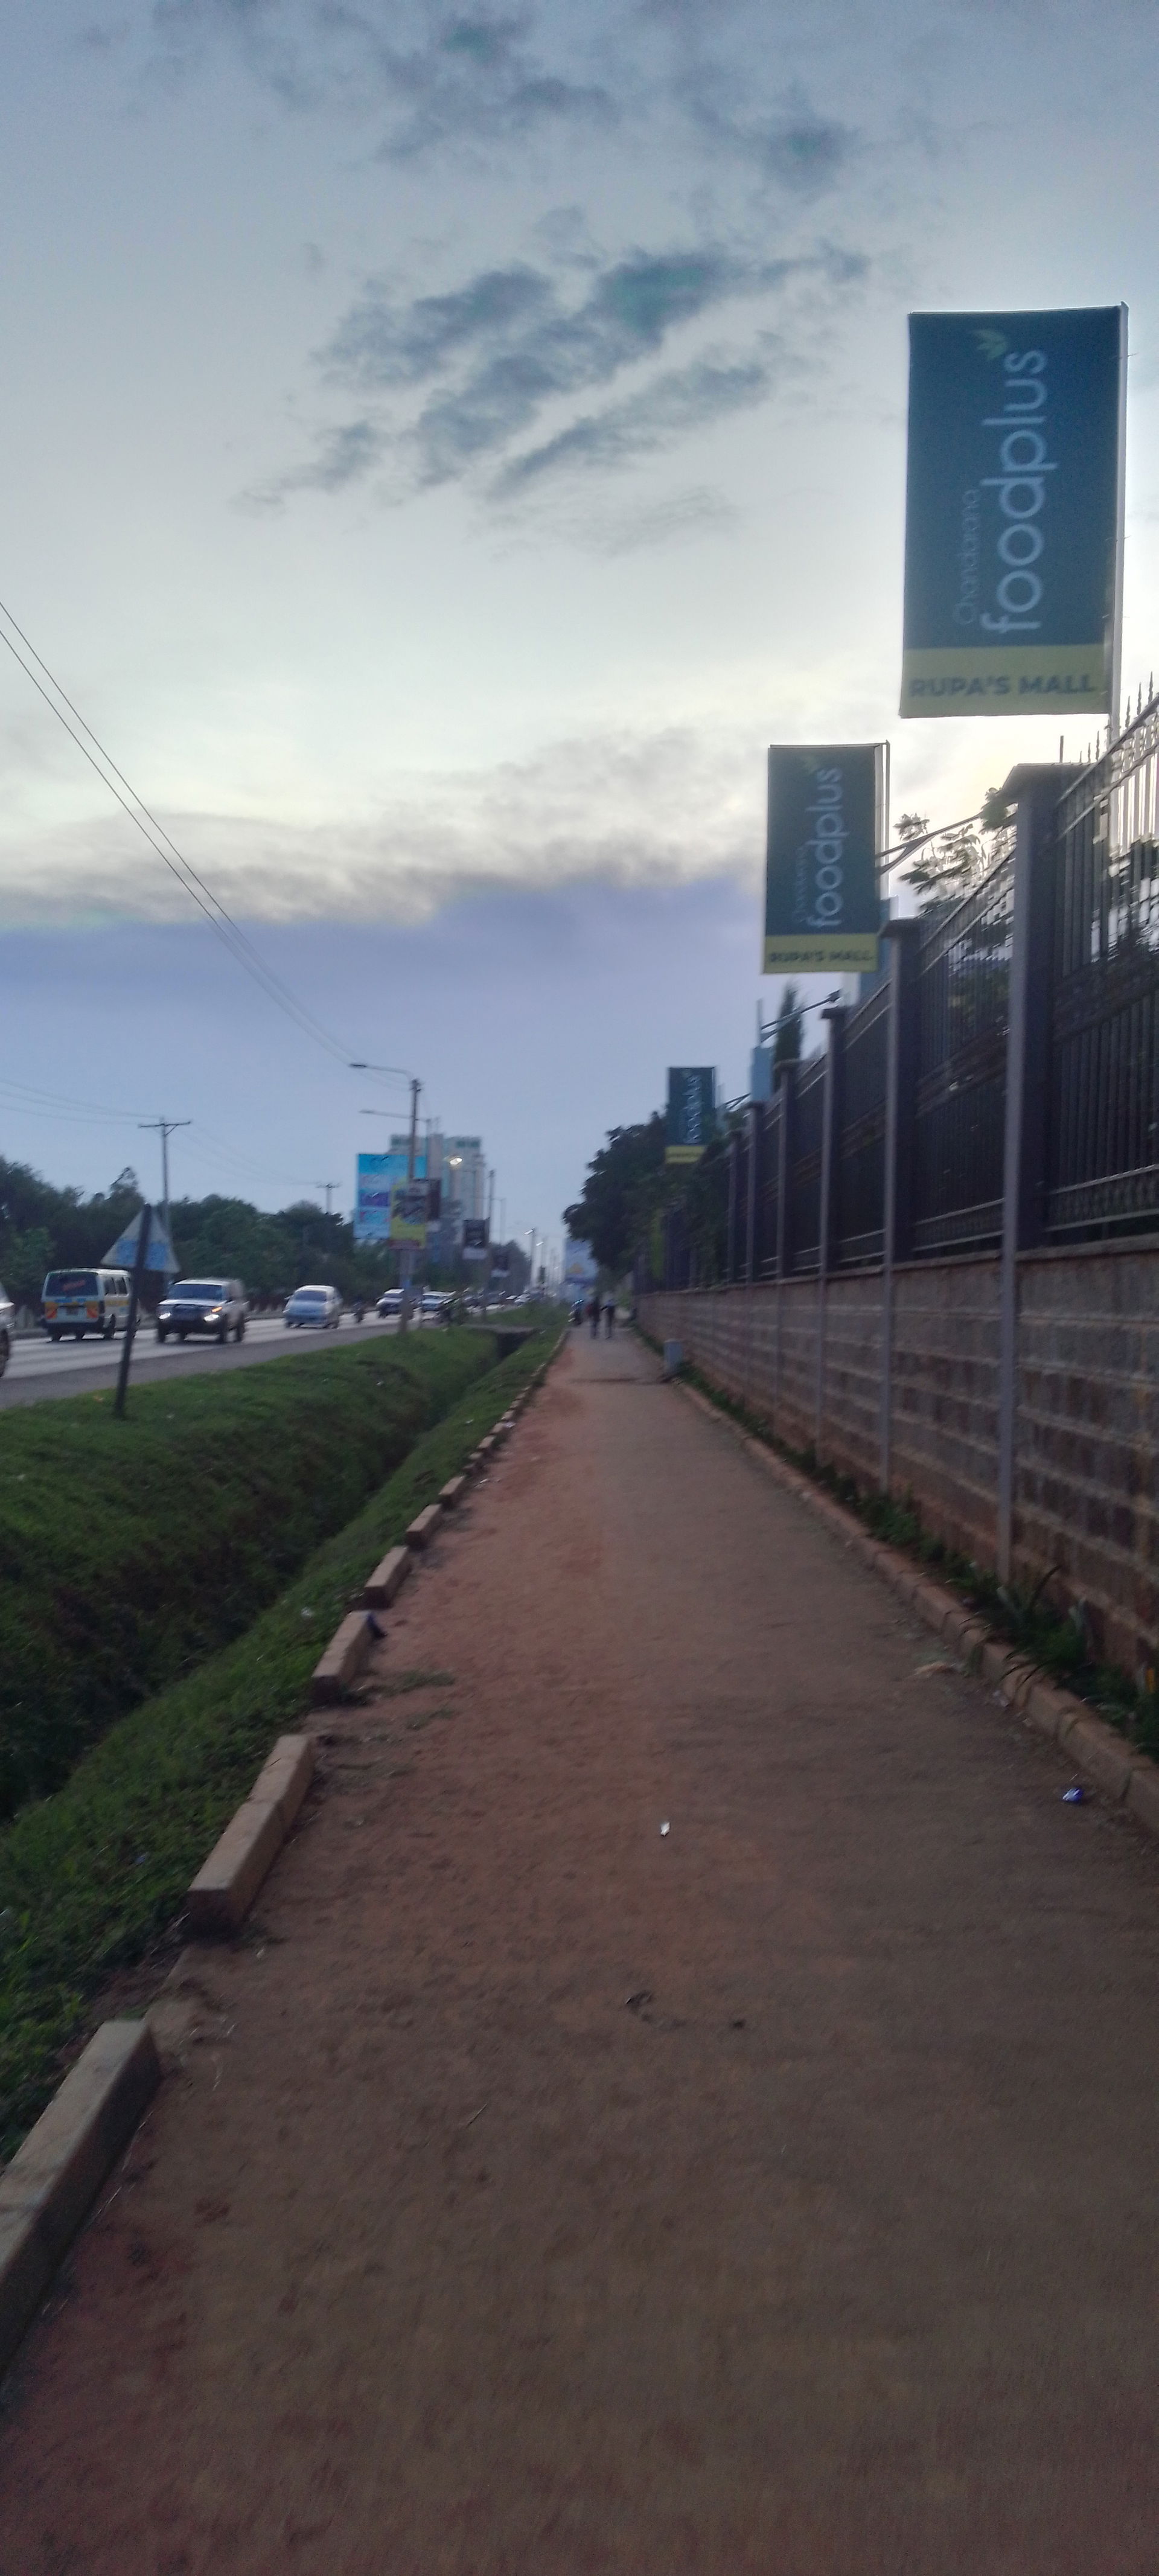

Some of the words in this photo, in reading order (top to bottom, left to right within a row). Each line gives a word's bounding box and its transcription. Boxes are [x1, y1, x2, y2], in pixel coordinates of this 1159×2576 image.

[980, 348, 1058, 634] foodplus
[909, 674, 1012, 697] RUPA'S
[1018, 673, 1096, 695] MALL
[806, 767, 849, 928] foodplus
